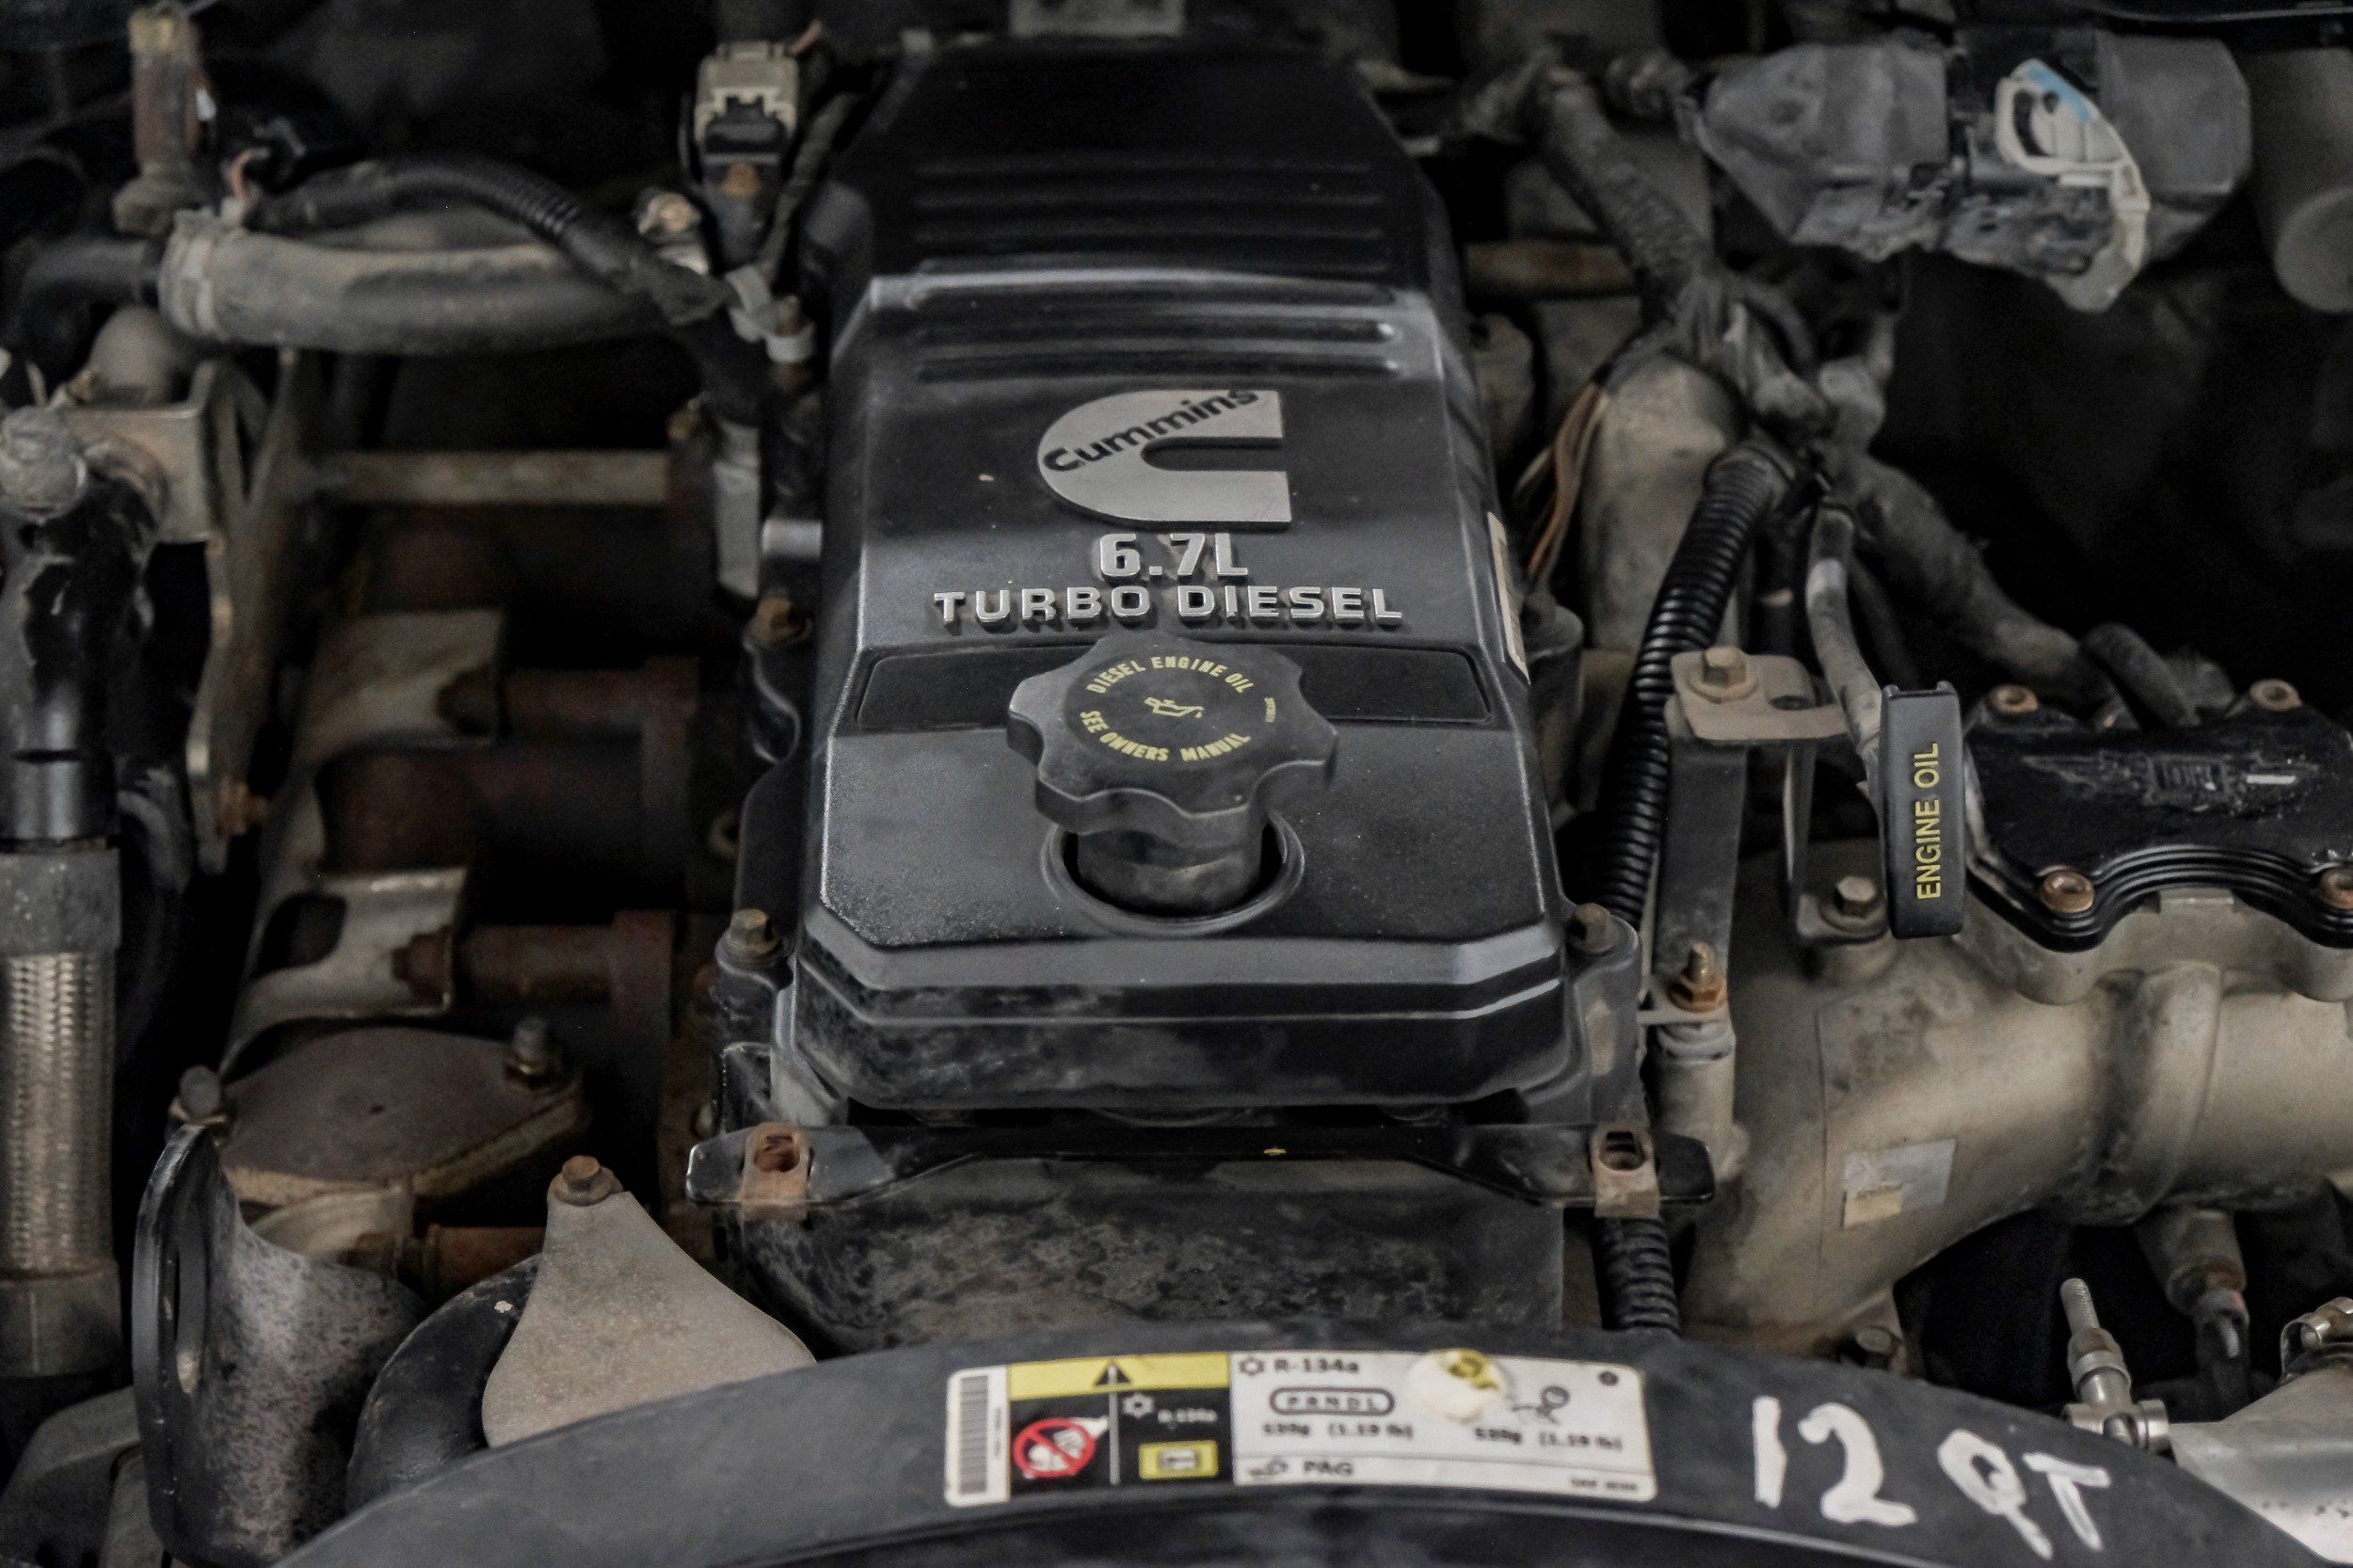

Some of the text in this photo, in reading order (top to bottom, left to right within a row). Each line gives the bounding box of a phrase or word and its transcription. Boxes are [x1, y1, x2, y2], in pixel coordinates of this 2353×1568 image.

[1042, 389, 1258, 472] Cummins
[1099, 533, 1248, 577] 6.7L
[934, 585, 1402, 624] TURBO DIESEL
[1086, 656, 1255, 694] DIESEL ENGINE OIL
[1080, 710, 1252, 762] SEE OWNERS MANUAL
[1913, 743, 1942, 900] ENGINE OIL
[1753, 1396, 2111, 1560] 12 QT
